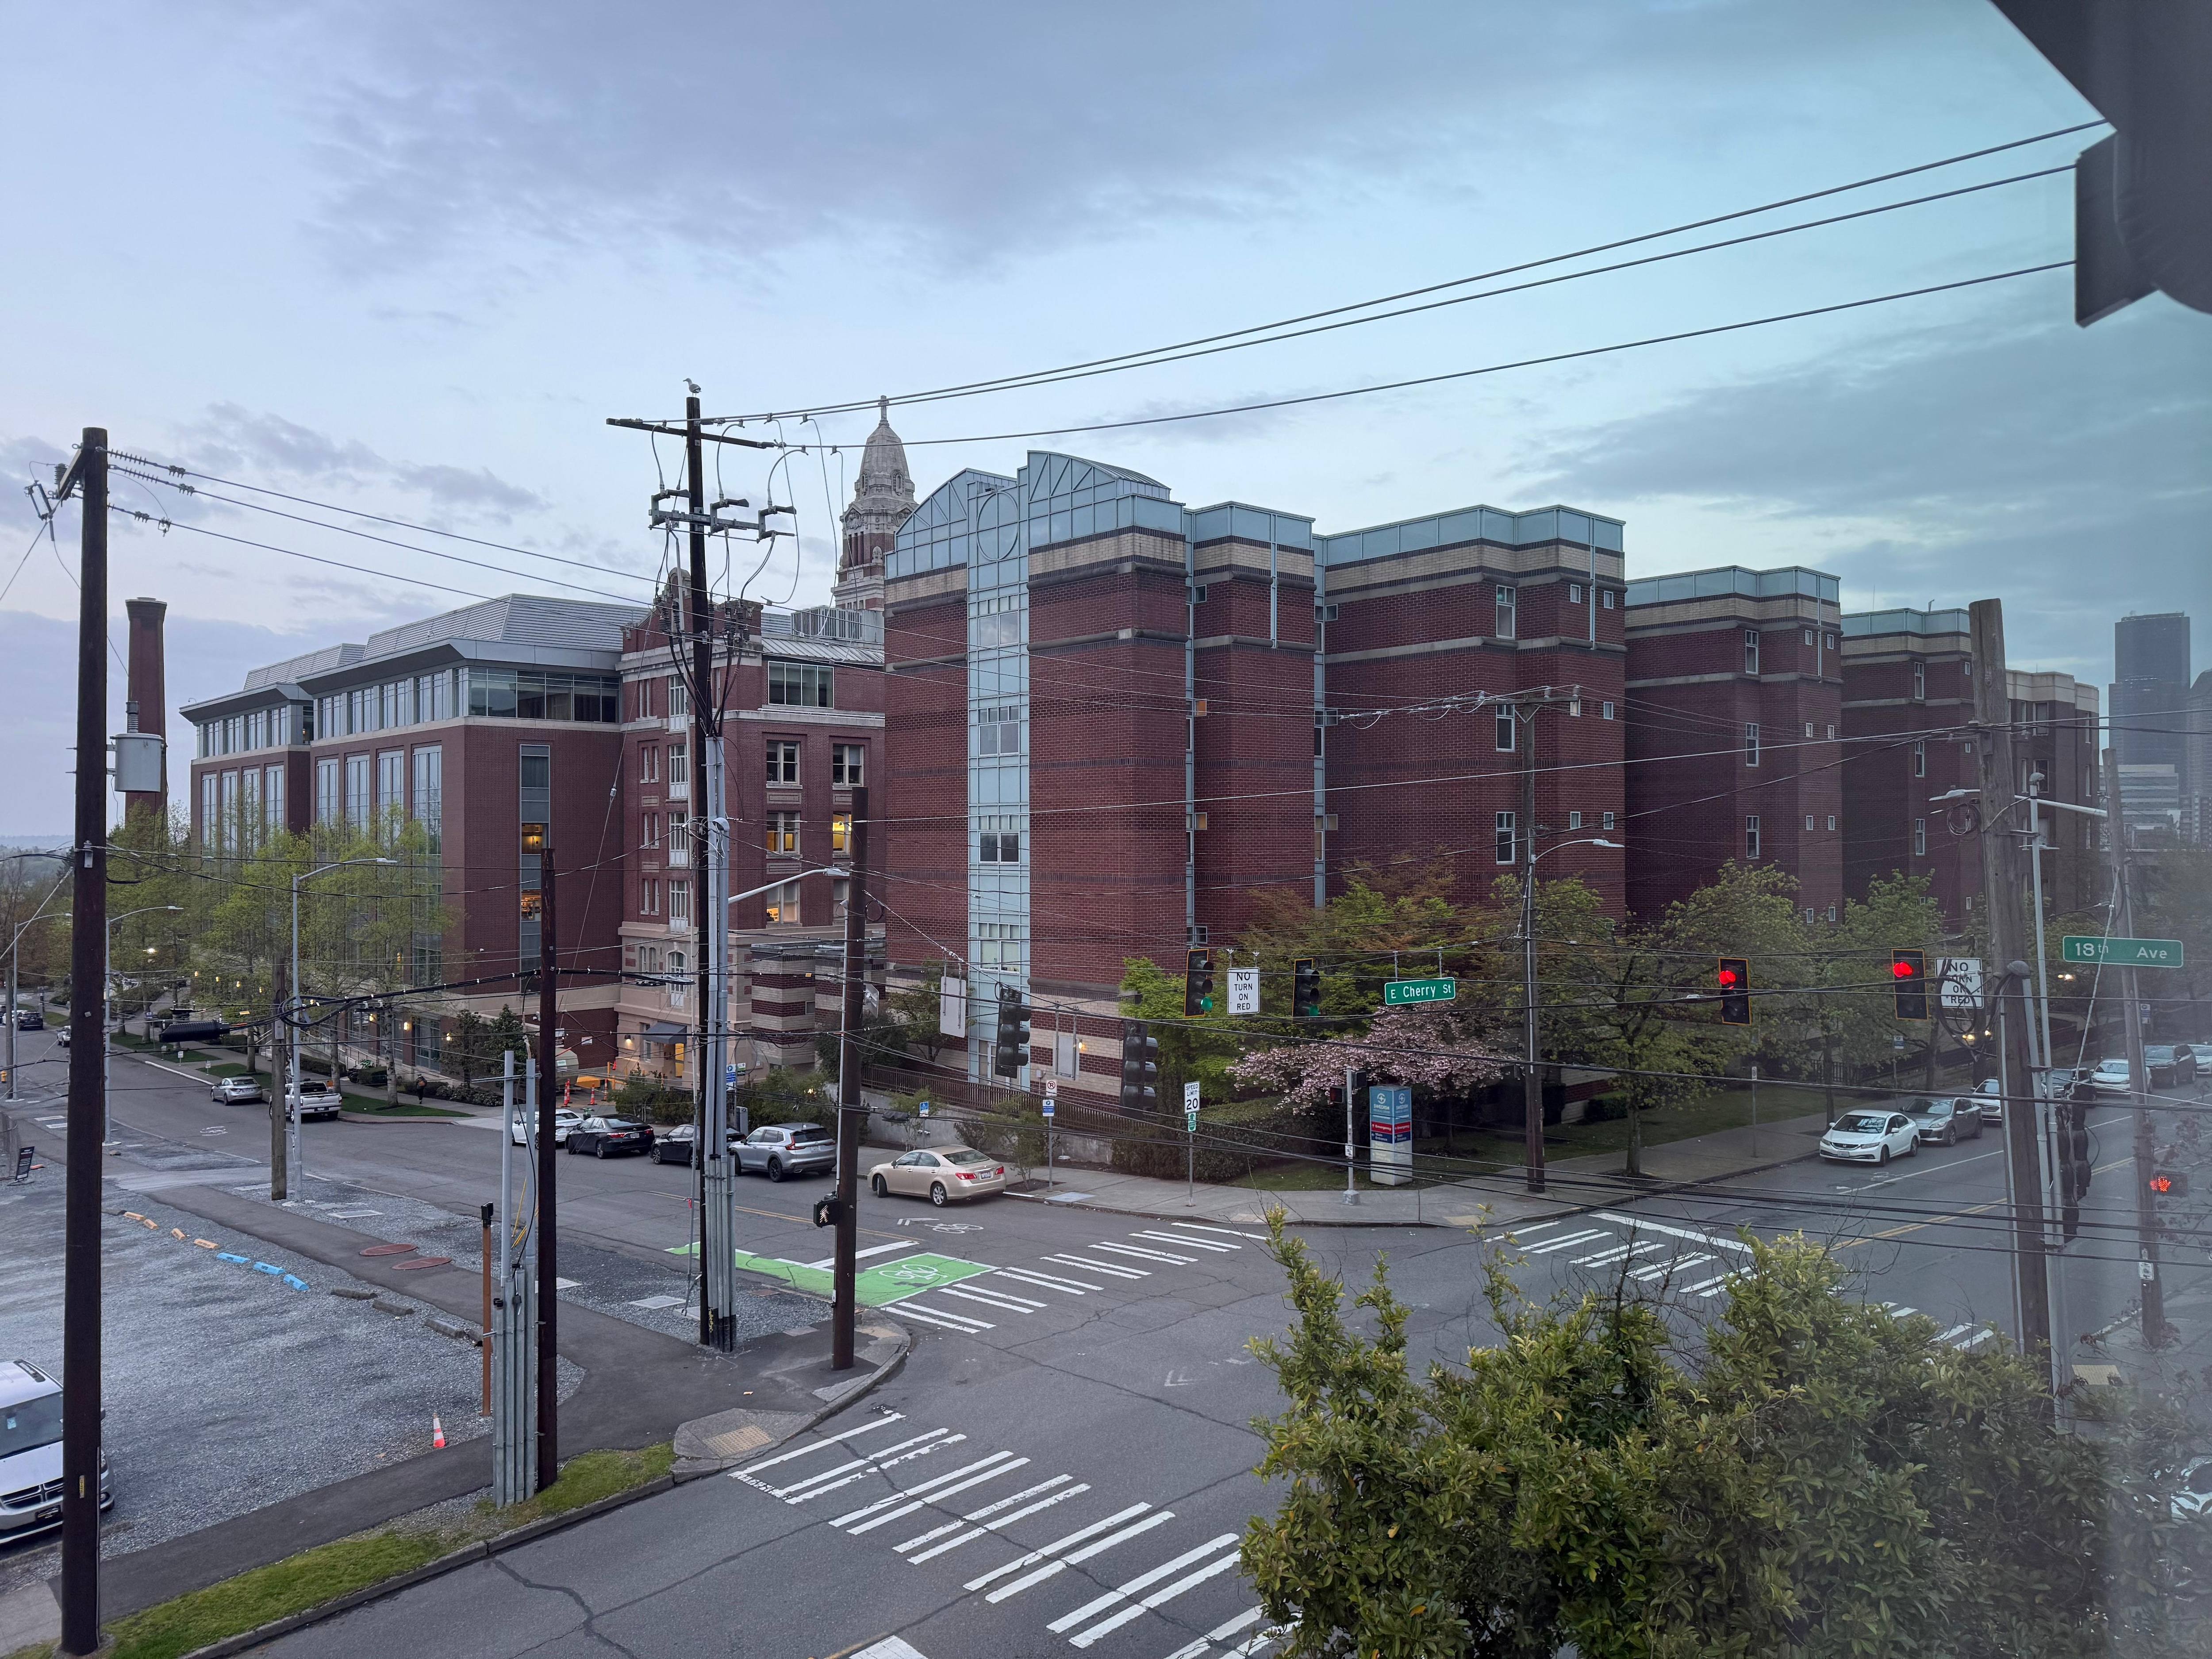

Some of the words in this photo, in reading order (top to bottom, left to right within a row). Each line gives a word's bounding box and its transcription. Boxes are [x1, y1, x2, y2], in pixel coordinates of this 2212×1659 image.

[2075, 942, 2108, 956] 18th
[2136, 947, 2167, 959] Ave
[1949, 962, 1968, 972] NO
[1237, 972, 1250, 981] NO
[1390, 989, 1396, 999] E
[1403, 986, 1436, 998] Cherry
[1443, 984, 1452, 994] St
[1187, 1098, 1198, 1110] 20
